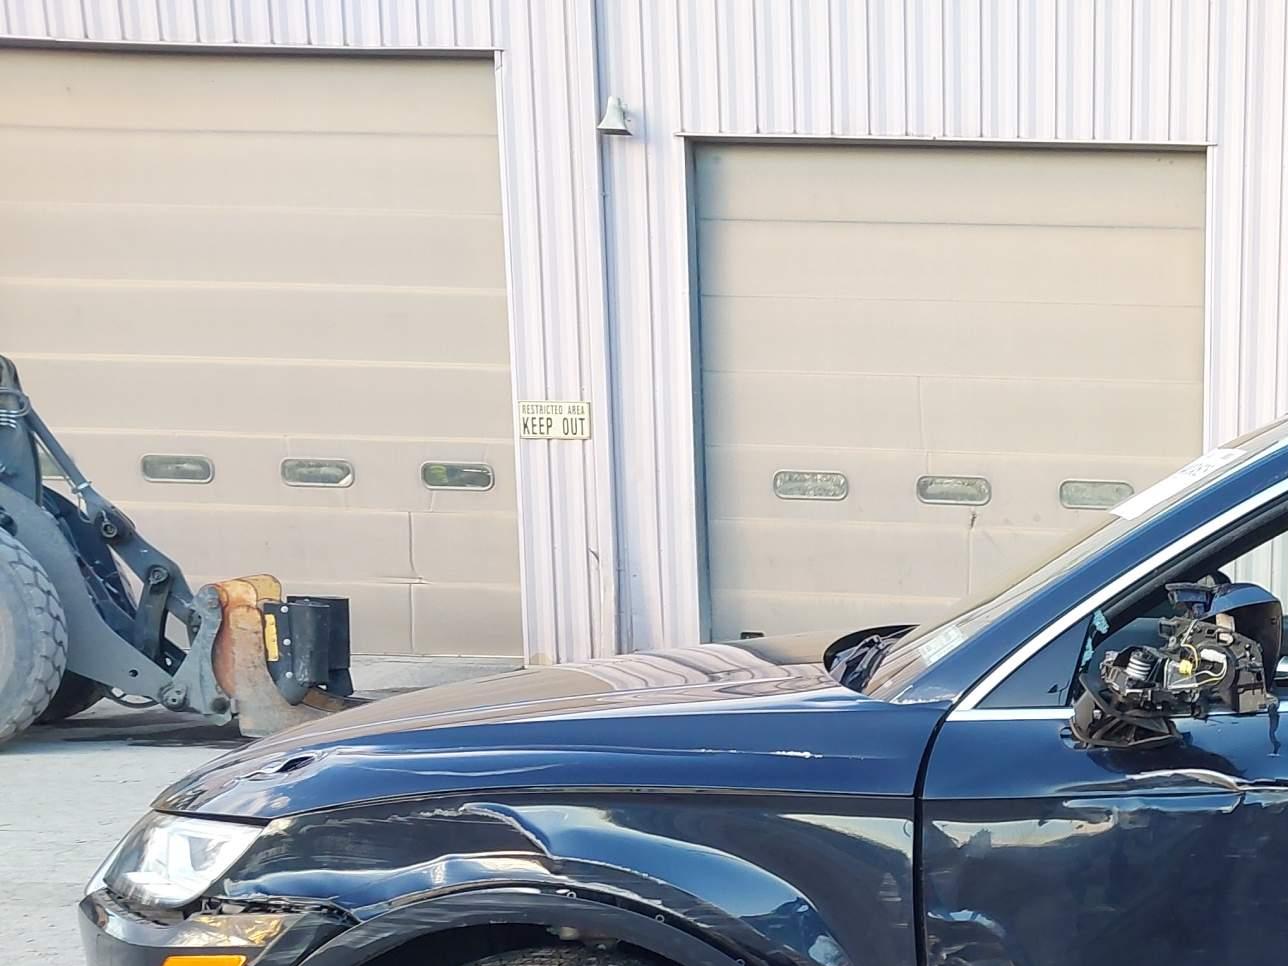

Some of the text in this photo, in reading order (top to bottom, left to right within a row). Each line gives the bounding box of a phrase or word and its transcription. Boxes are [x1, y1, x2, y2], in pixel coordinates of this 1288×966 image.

[522, 404, 585, 414] RESTRICTED AREA
[522, 417, 586, 435] KEEP OUT
